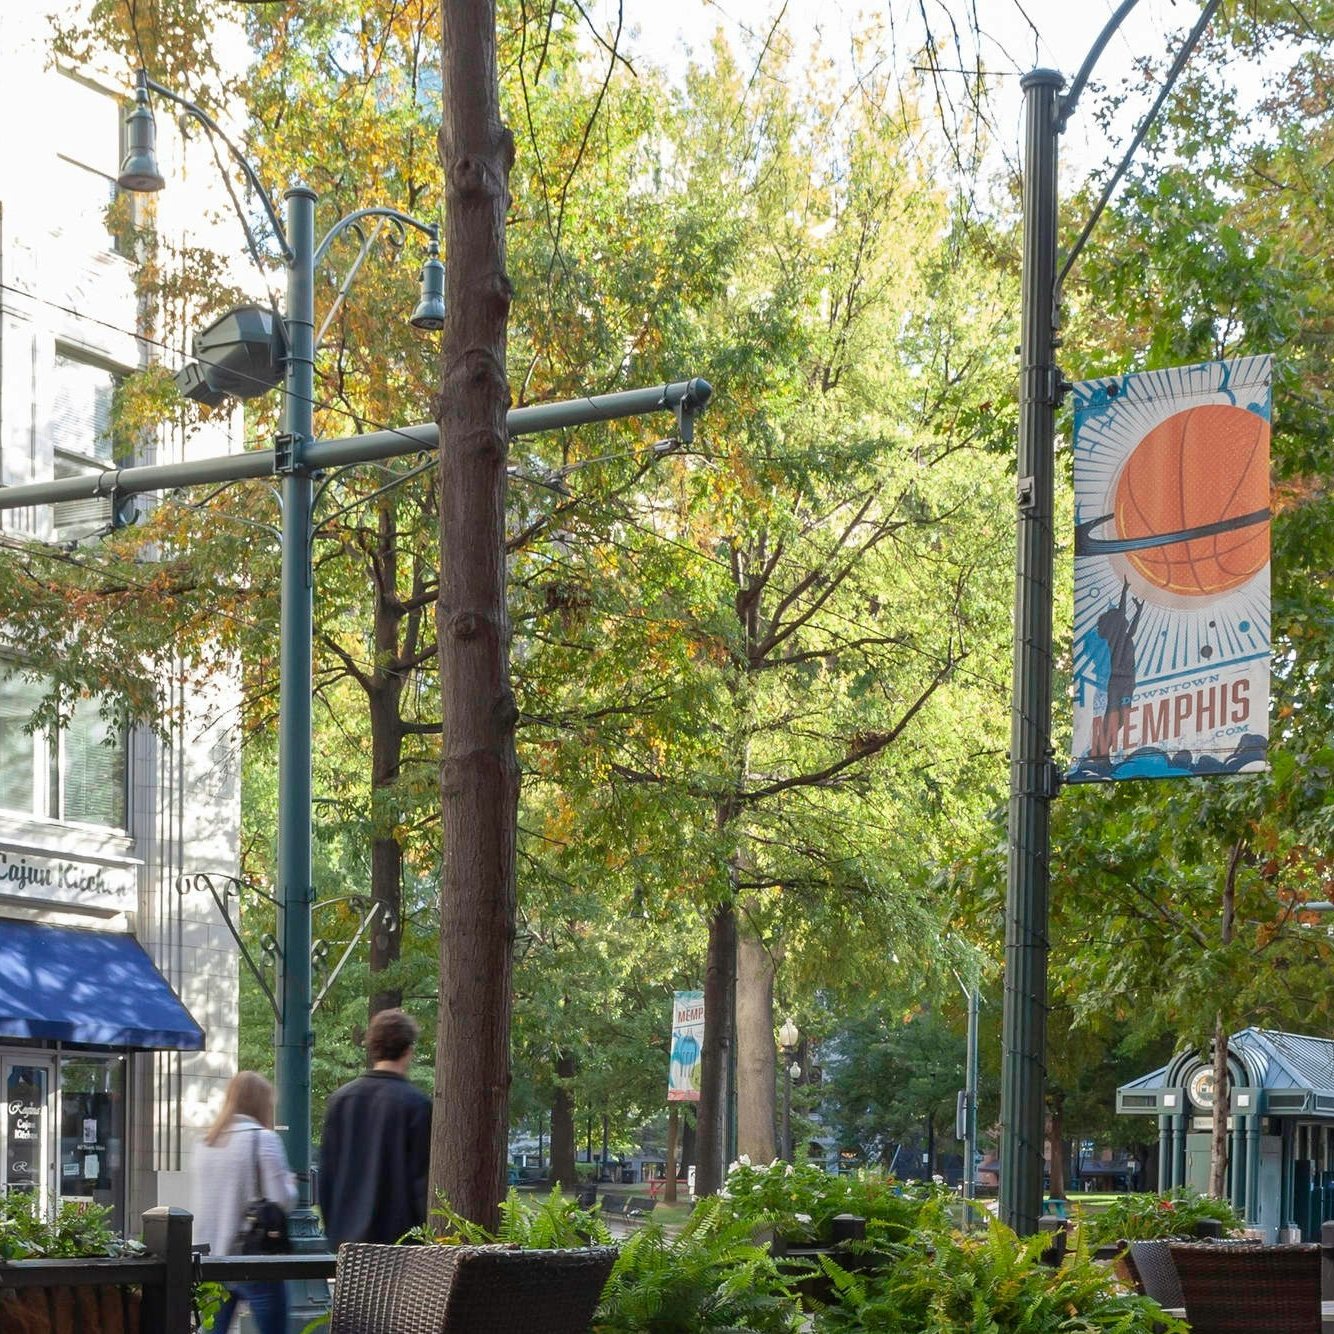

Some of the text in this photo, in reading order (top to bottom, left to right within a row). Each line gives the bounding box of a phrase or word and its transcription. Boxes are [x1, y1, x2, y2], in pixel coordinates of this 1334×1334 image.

[1121, 674, 1220, 705] DOWNTOWN
[1090, 678, 1250, 757] MEMPHIS
[678, 1007, 704, 1023] MEMP
